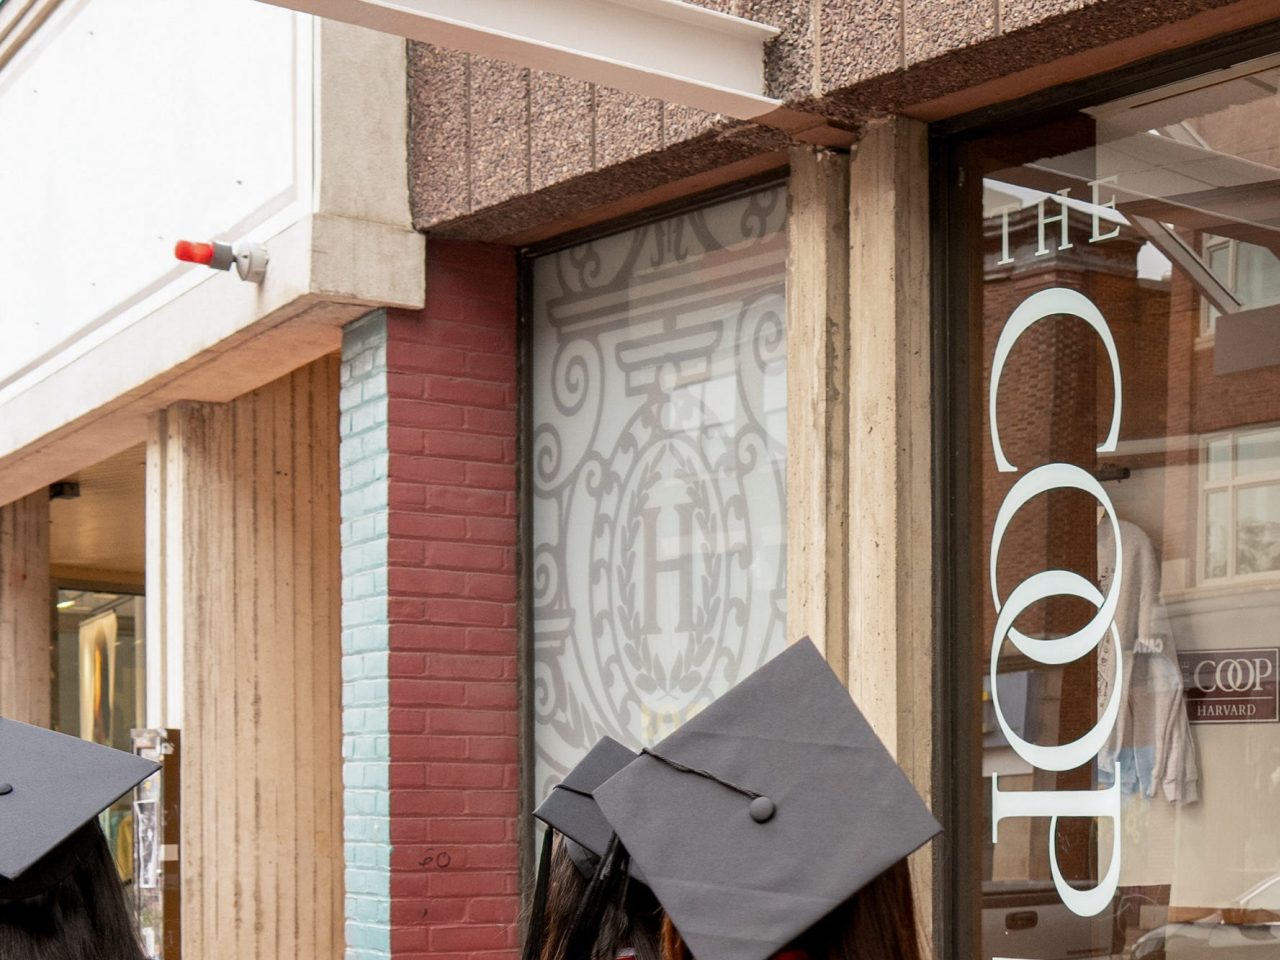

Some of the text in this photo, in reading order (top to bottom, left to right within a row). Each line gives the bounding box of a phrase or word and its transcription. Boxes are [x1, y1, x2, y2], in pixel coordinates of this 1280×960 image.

[989, 175, 1121, 266] THE
[989, 287, 1122, 918] COOP
[1193, 658, 1273, 693] COOP
[1197, 704, 1257, 717] HARVARD
